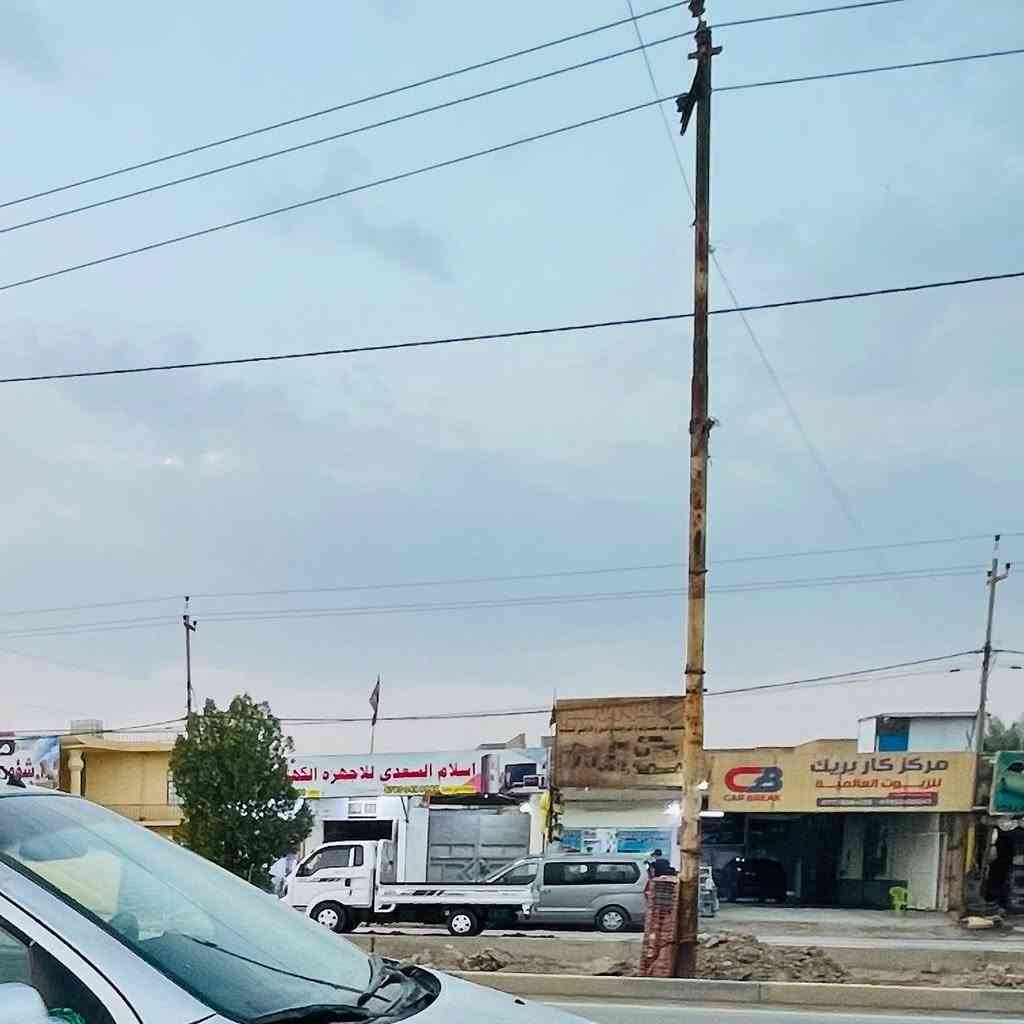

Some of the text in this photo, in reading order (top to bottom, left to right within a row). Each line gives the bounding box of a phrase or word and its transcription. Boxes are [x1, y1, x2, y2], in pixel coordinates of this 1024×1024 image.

[438, 762, 477, 783] اسلام
[810, 757, 950, 775] مركز كار بريك
